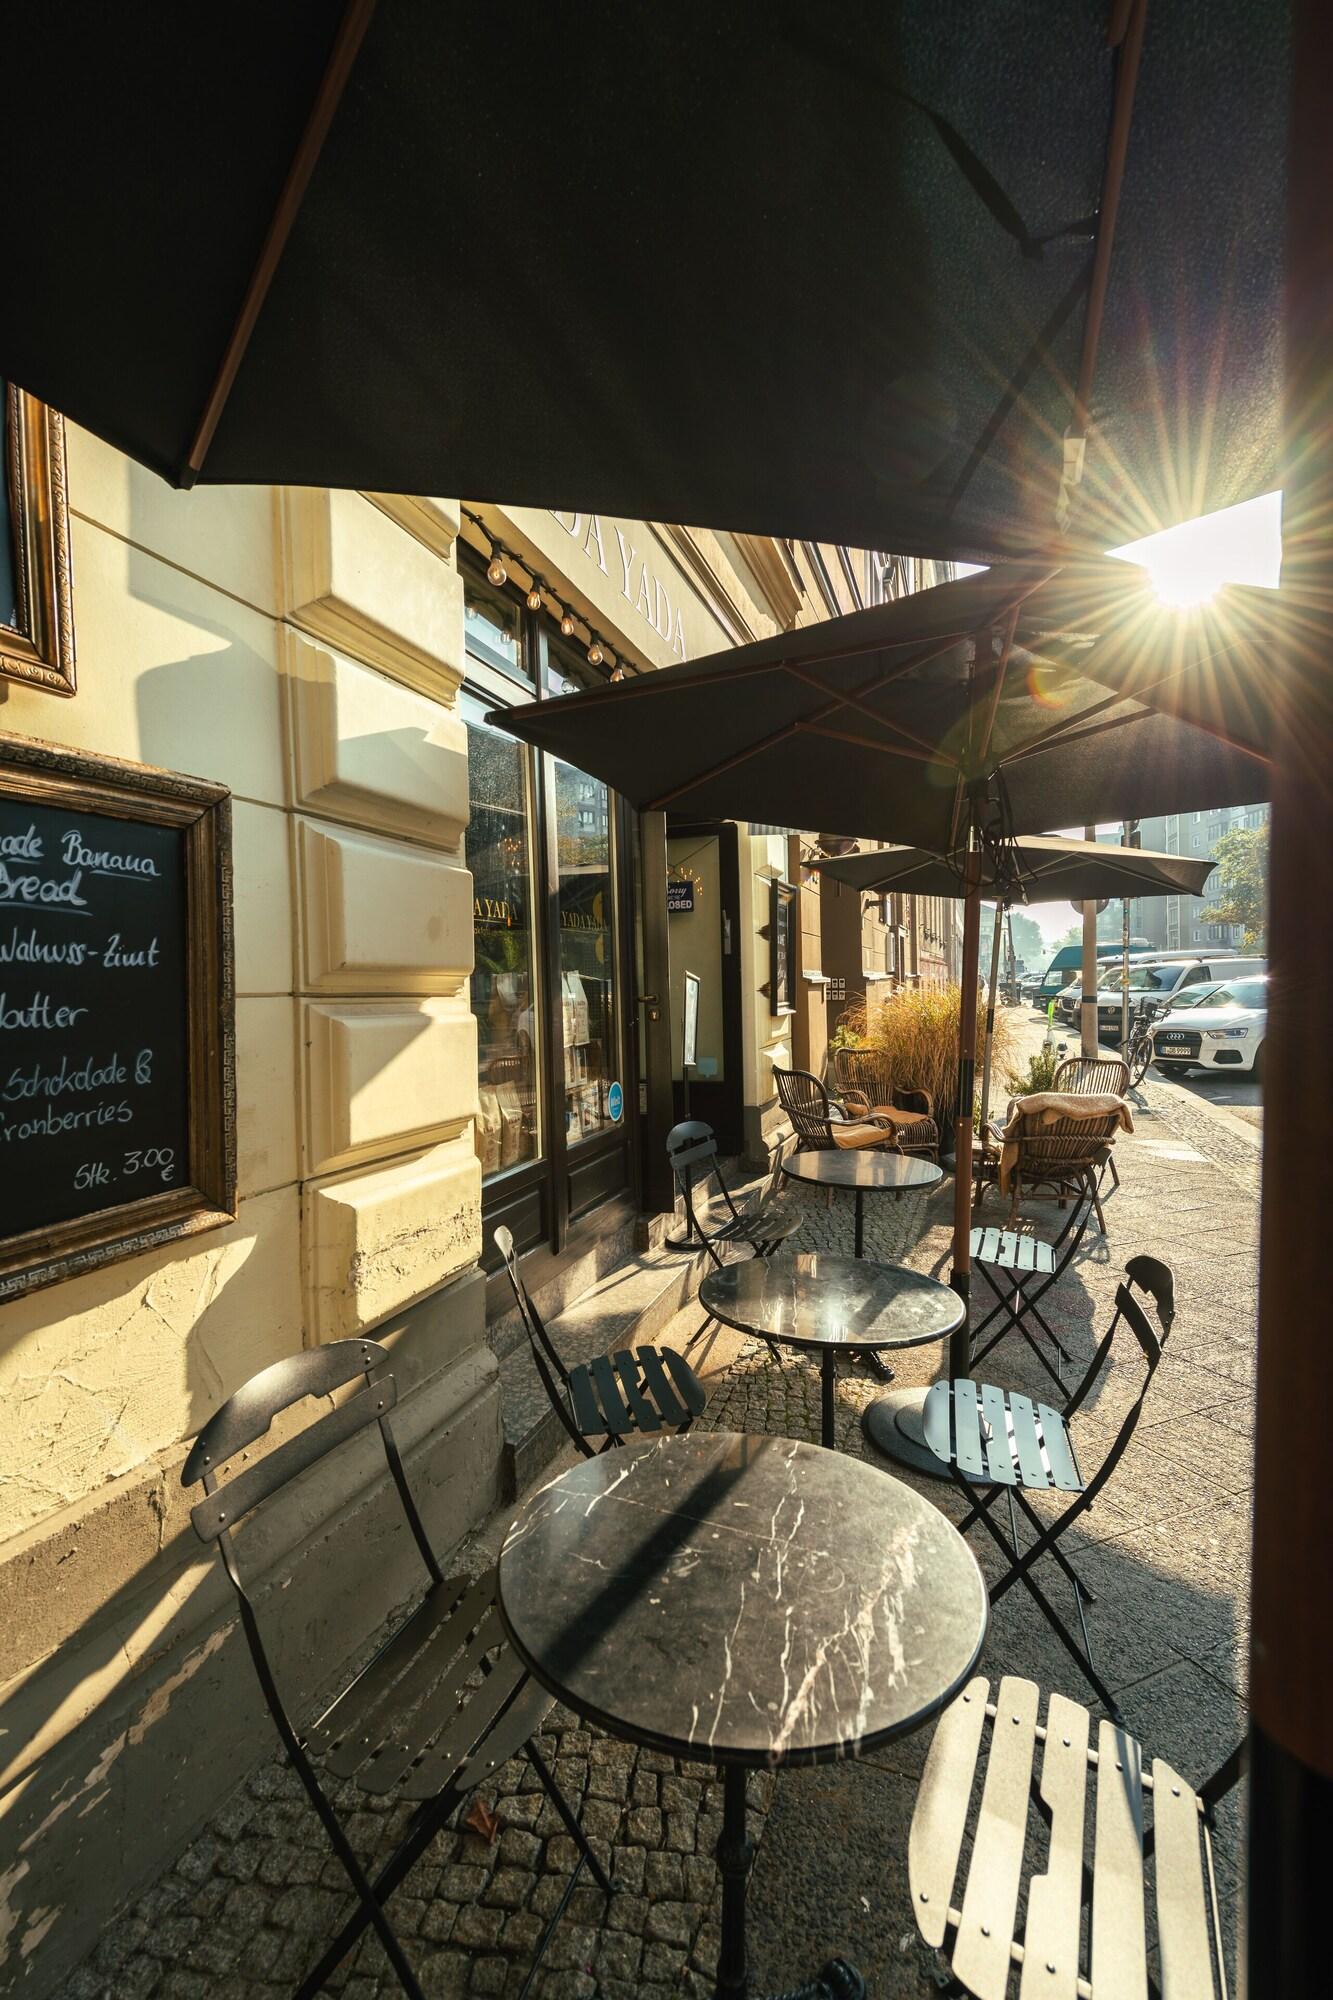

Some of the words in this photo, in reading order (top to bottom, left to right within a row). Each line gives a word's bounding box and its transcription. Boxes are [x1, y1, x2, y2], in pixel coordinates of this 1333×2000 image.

[614, 525, 687, 663] YADA
[0, 824, 44, 857] ade
[61, 829, 161, 877] Banana
[667, 899, 692, 910] OSED
[134, 1048, 153, 1084] &
[73, 1162, 118, 1190] Stk.
[122, 1148, 174, 1175] 3.00
[160, 1164, 175, 1182] €
